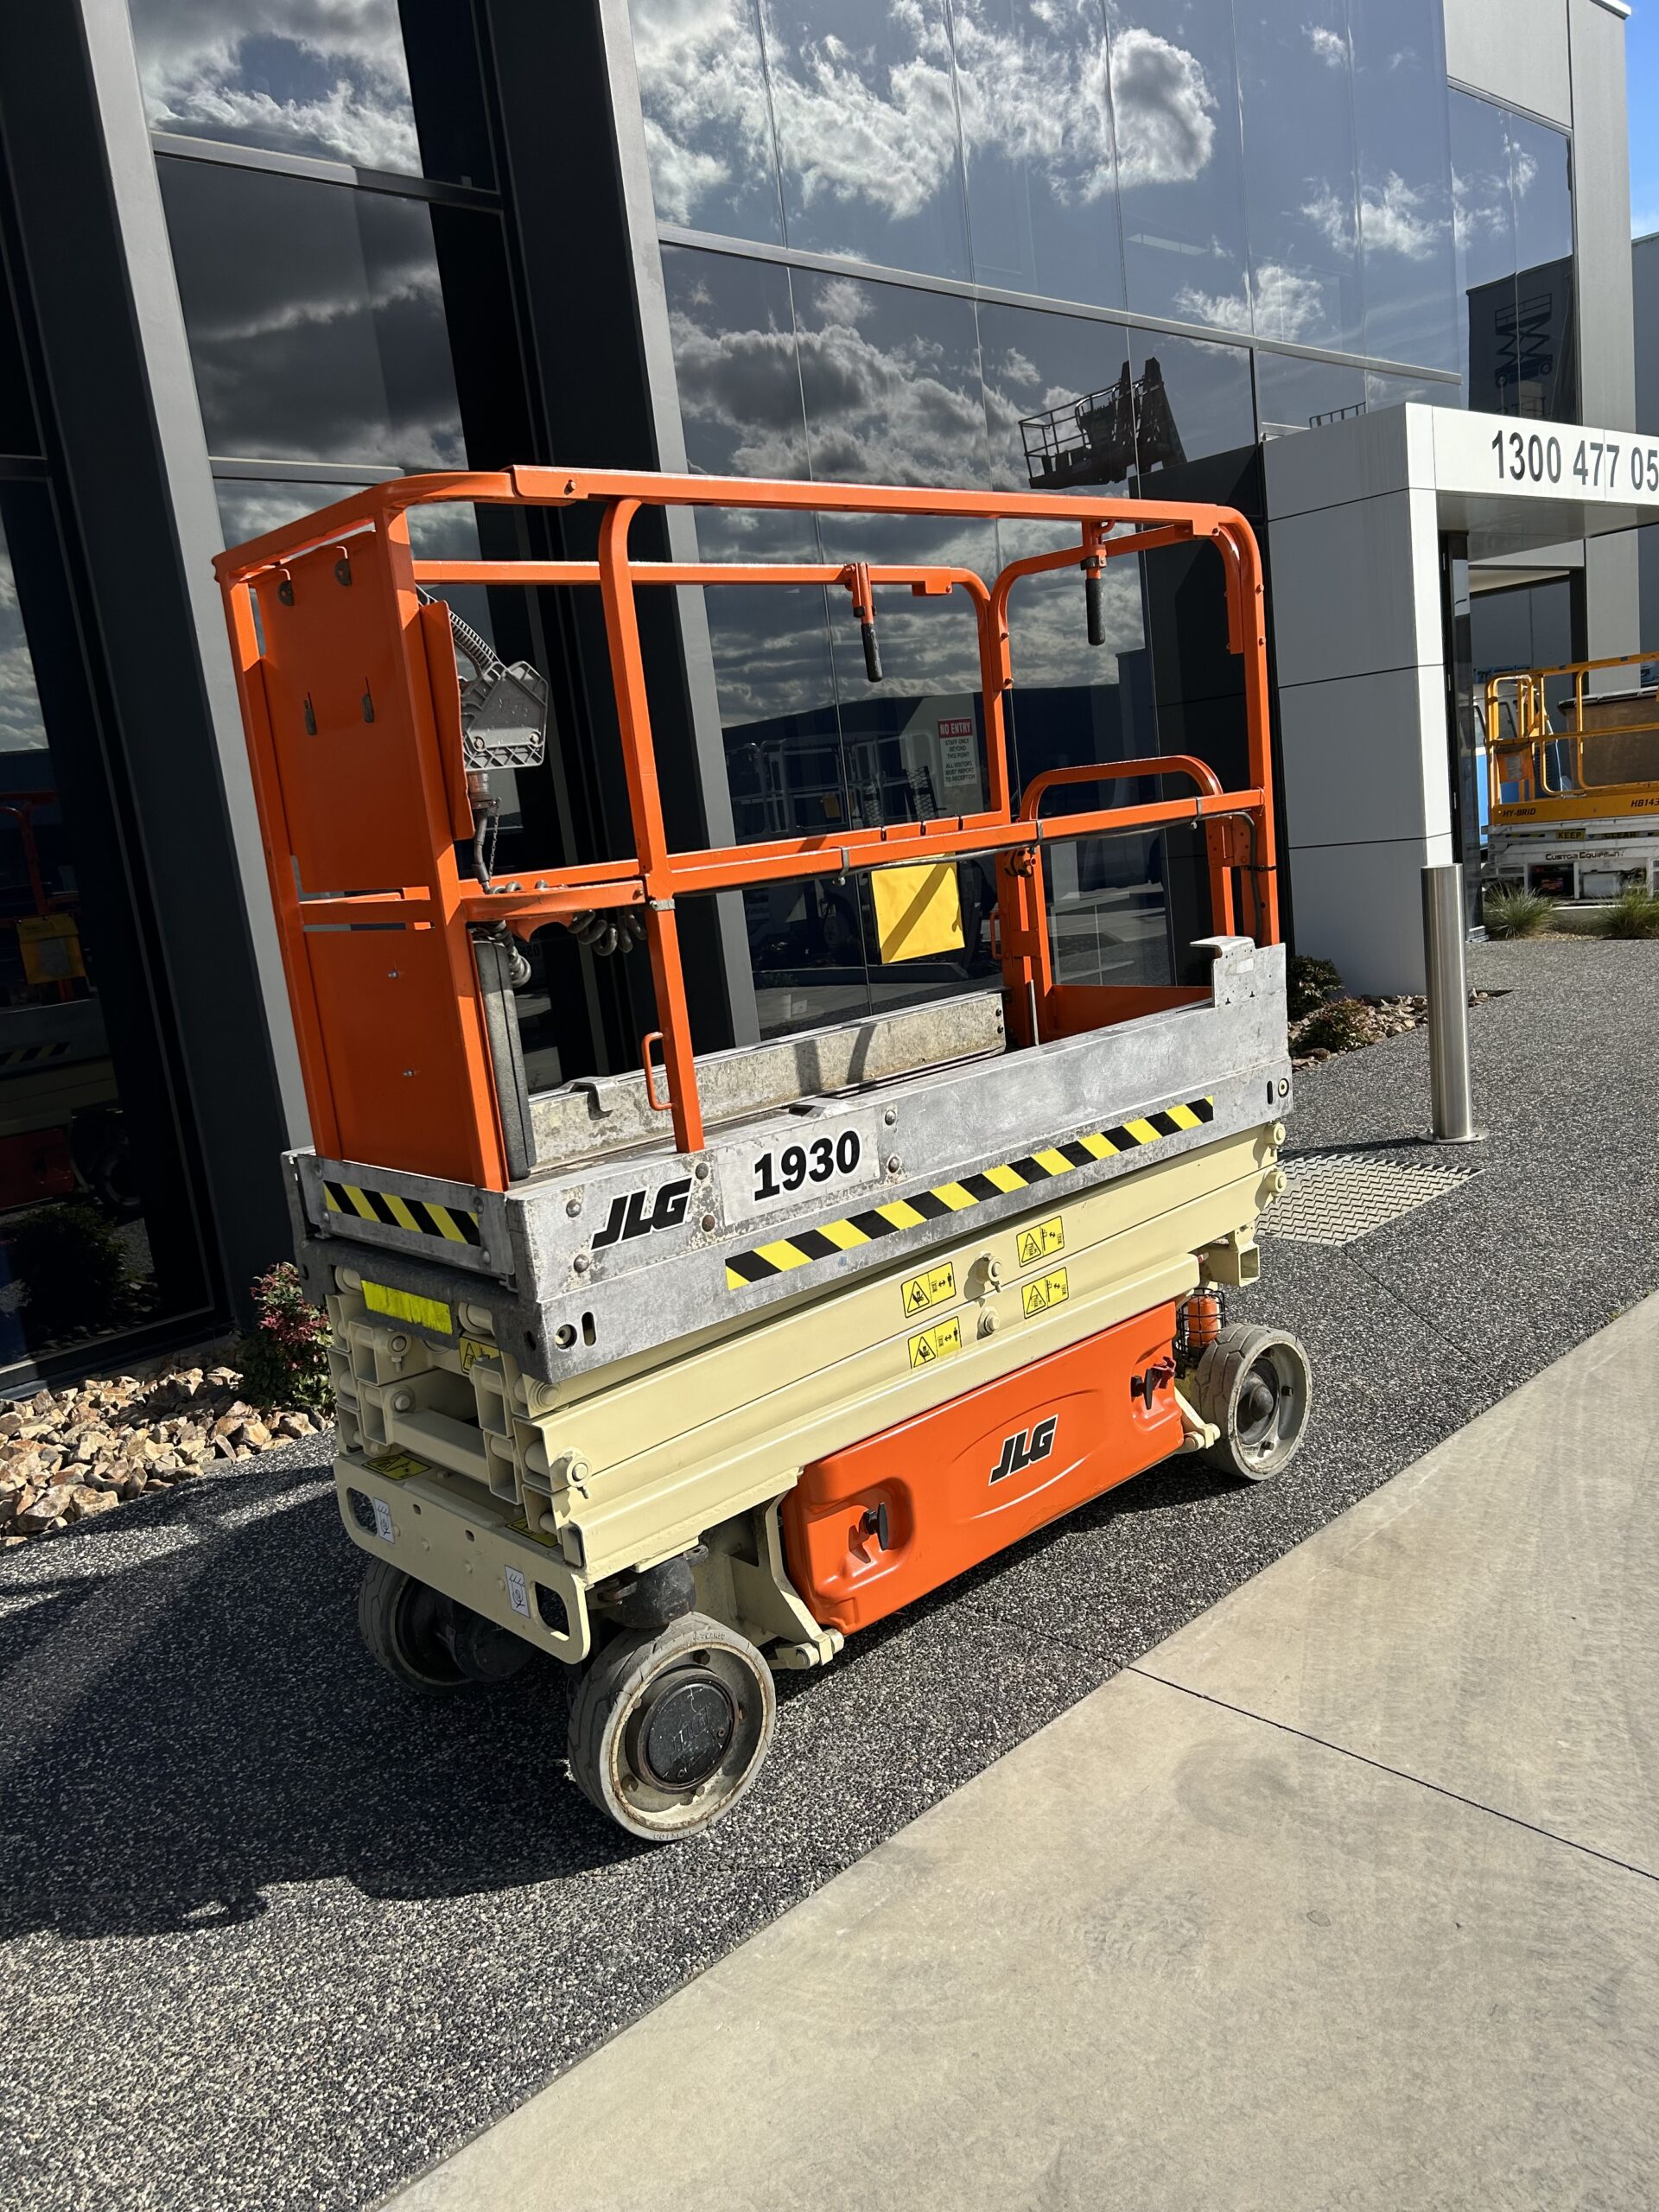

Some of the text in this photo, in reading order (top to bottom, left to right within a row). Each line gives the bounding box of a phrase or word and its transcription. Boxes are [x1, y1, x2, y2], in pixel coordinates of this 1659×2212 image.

[1491, 430, 1562, 484] 1300
[1573, 440, 1620, 488] 477
[939, 721, 971, 734] NO ENTRY
[1502, 808, 1536, 818] HY-BRID
[753, 1128, 861, 1203] 1930
[591, 1177, 693, 1251] JLG
[988, 1414, 1058, 1486] JLG
